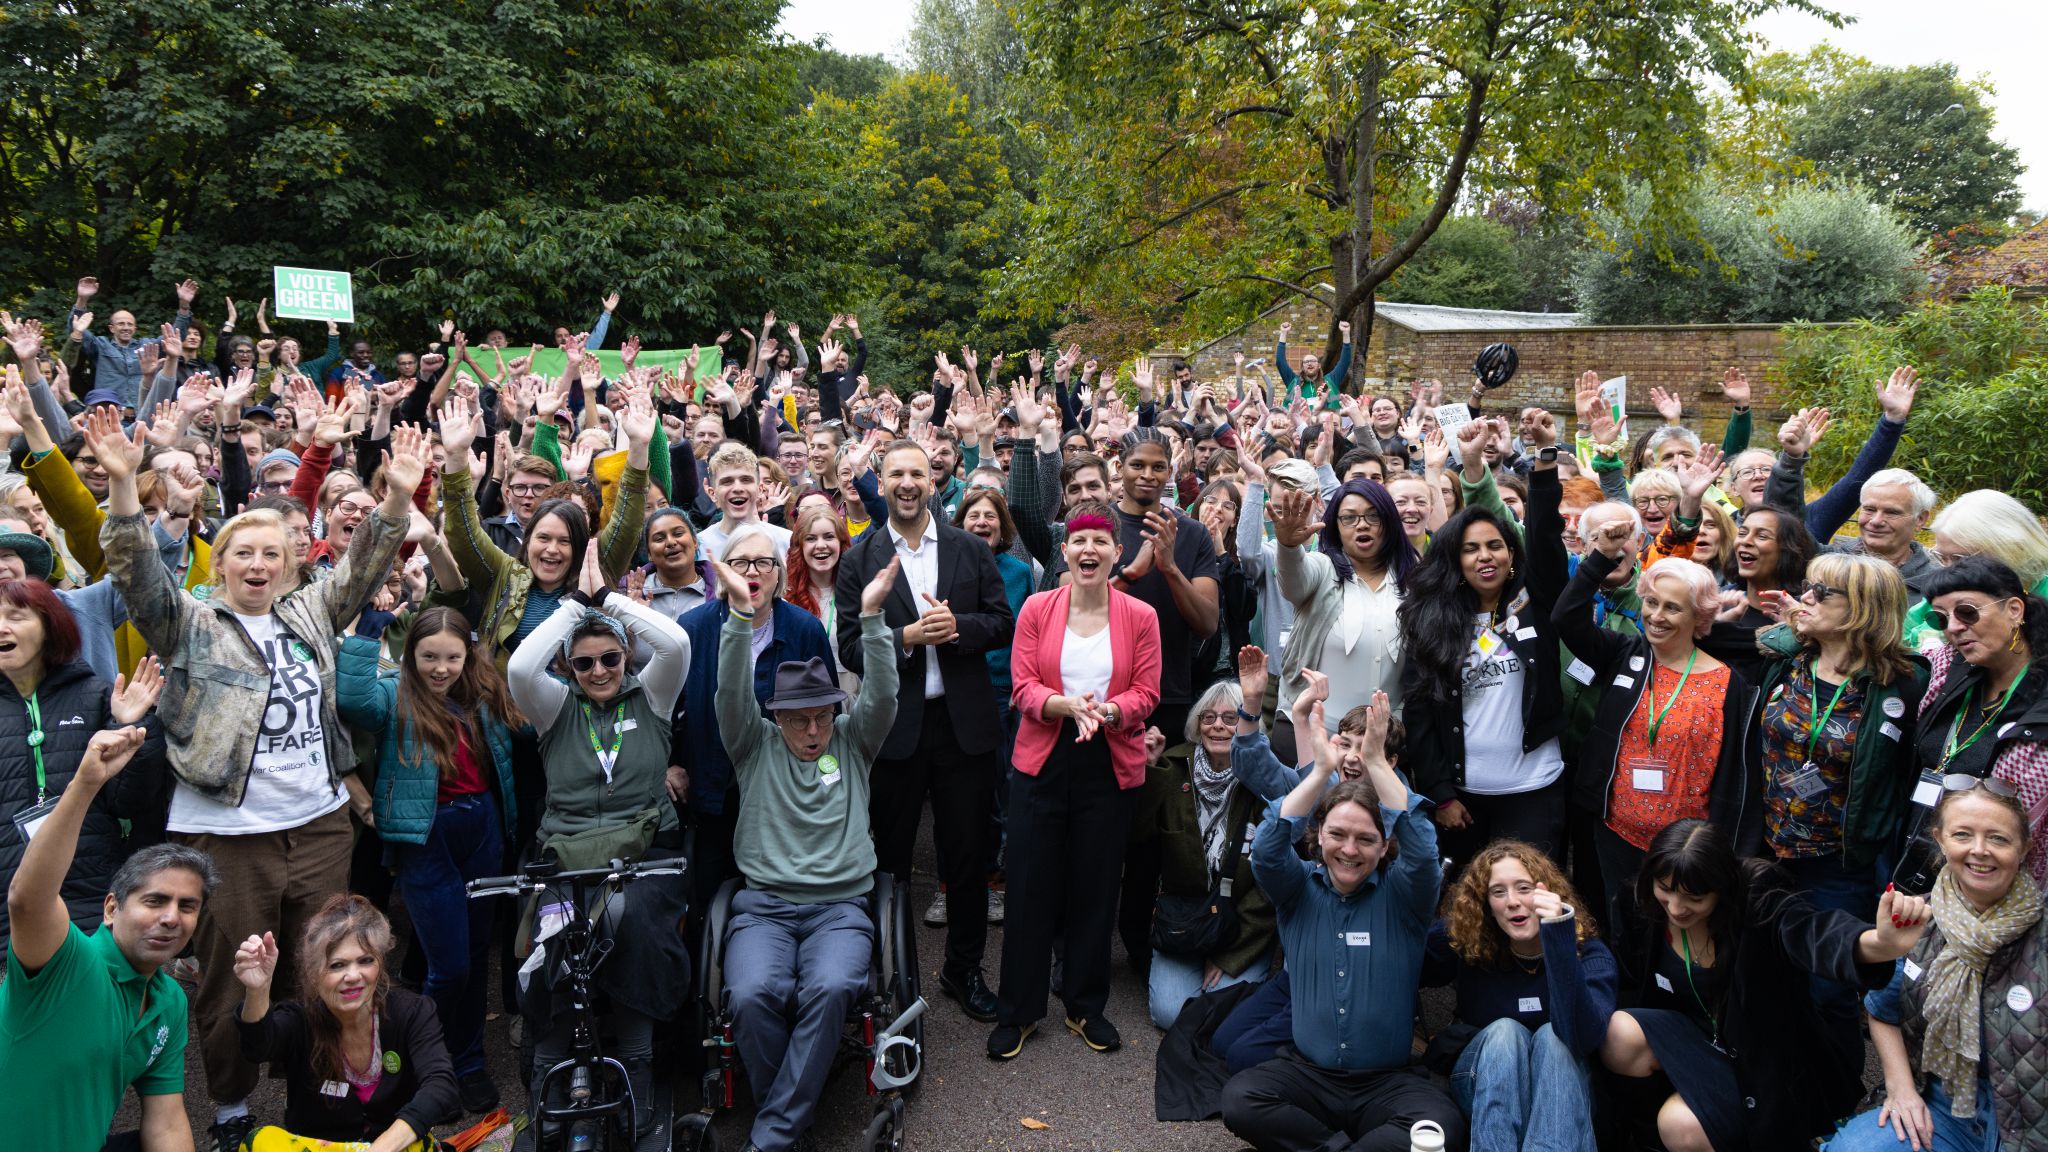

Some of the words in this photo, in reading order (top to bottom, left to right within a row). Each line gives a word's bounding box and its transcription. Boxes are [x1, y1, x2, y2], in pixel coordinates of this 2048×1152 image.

[288, 272, 337, 292] VOTE
[279, 288, 349, 311] GREEN
[260, 687, 319, 737] OT
[255, 725, 322, 755] LFARE
[268, 762, 306, 773] Coalition
